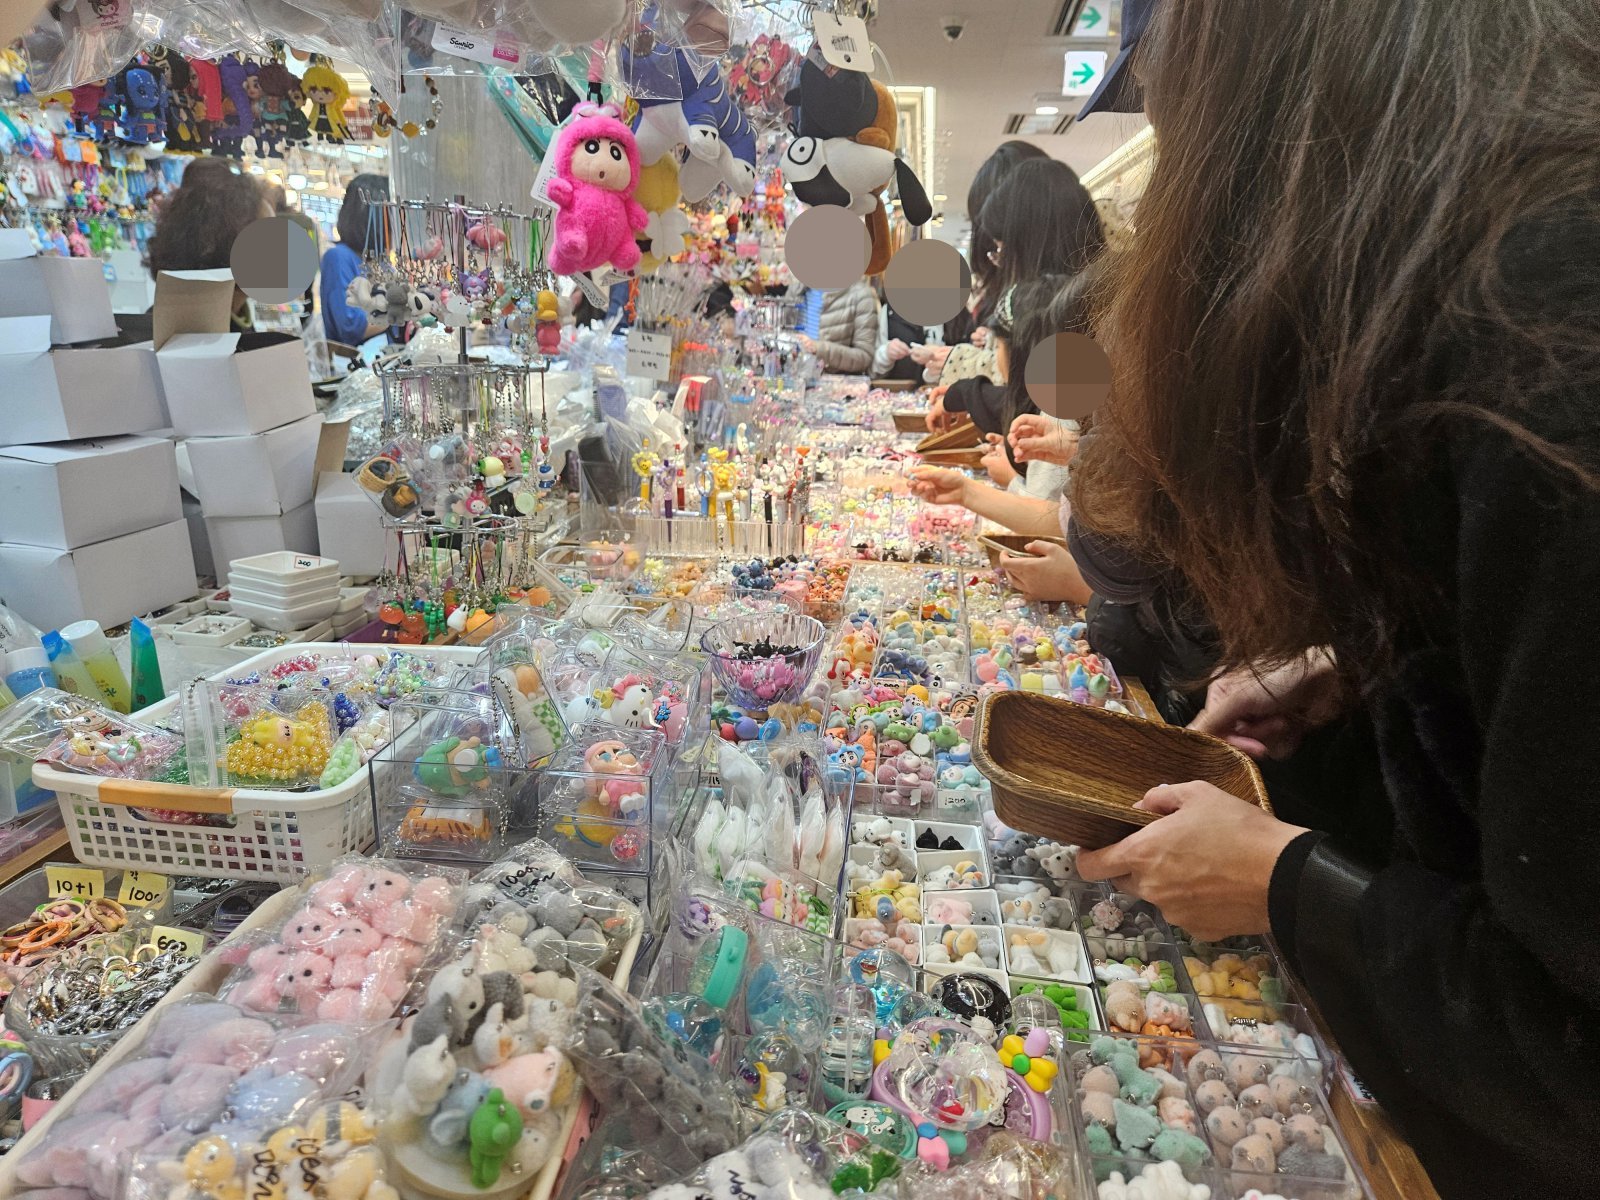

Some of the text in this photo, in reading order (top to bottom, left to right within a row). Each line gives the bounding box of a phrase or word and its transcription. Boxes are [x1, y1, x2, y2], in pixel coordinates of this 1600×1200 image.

[449, 37, 474, 49] Sanrio
[298, 559, 311, 567] 200
[56, 880, 93, 896] 10+1
